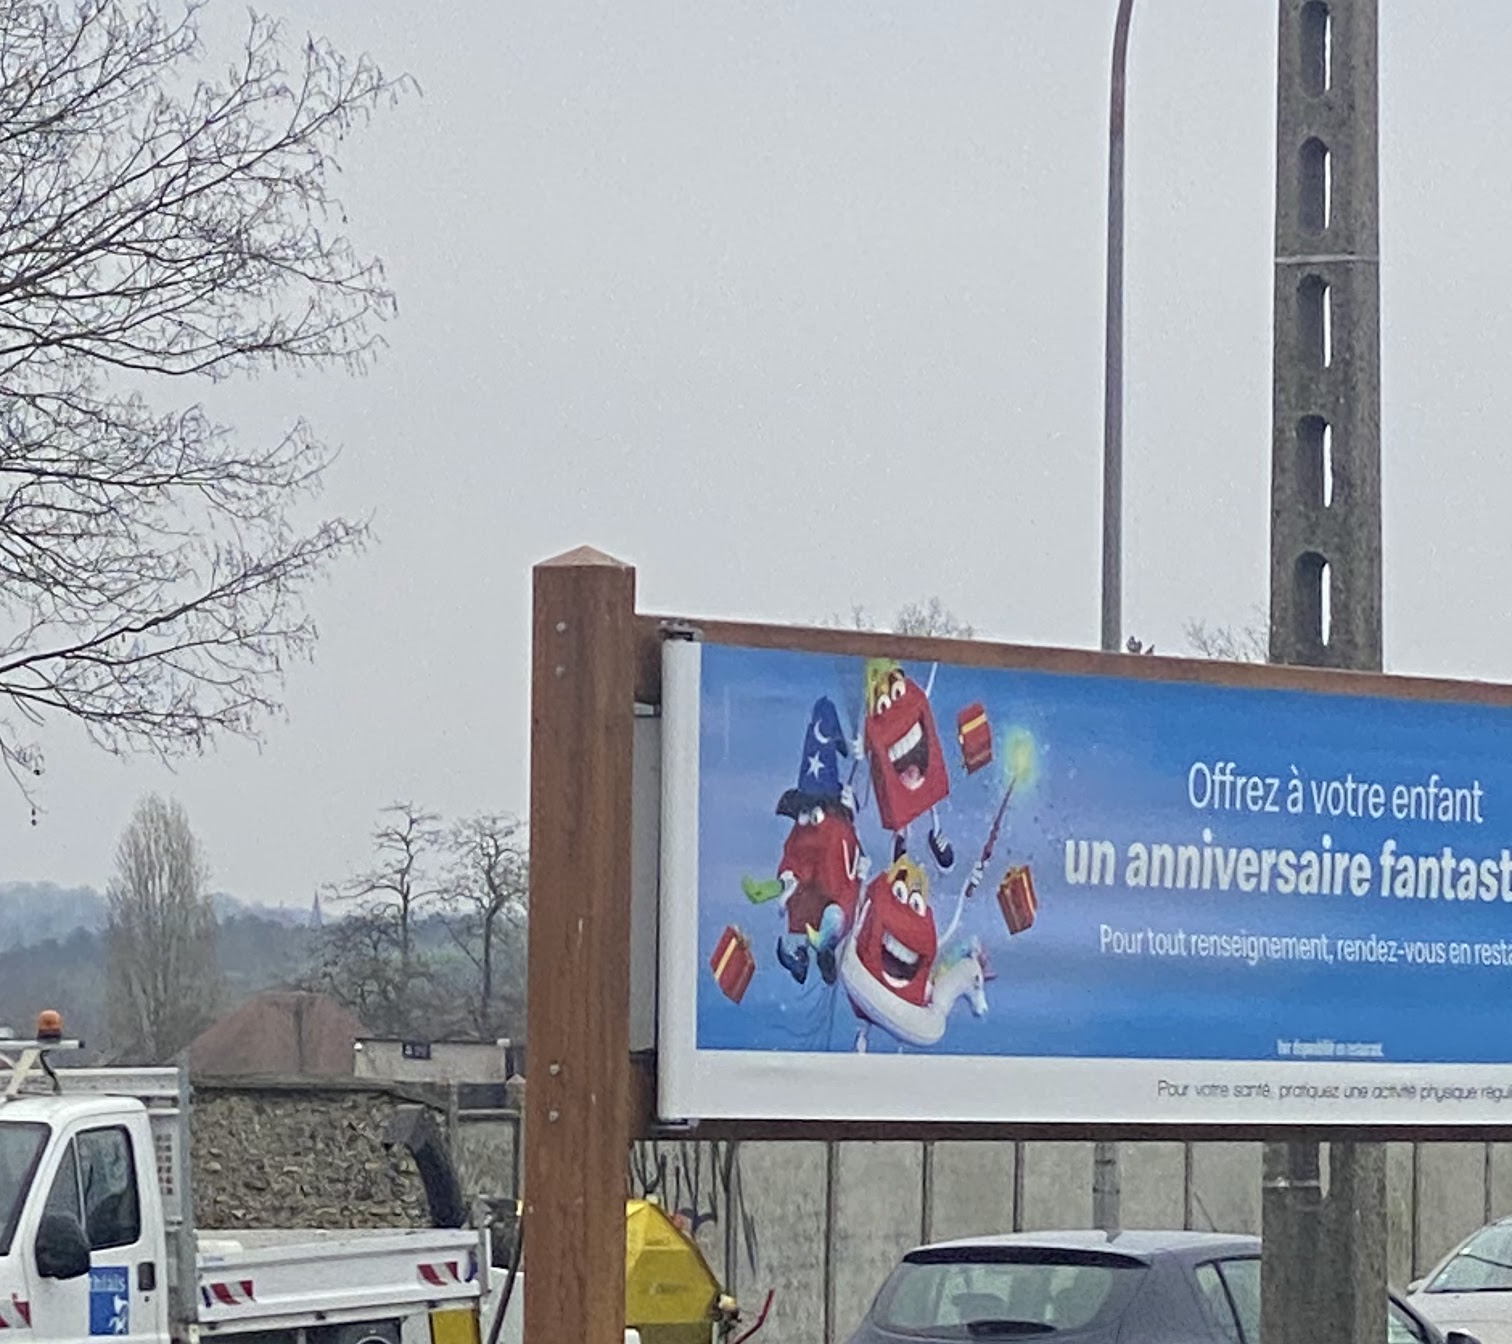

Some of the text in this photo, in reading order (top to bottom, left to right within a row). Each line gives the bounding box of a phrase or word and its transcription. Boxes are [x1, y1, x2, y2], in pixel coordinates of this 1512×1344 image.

[1188, 761, 1484, 824] Offrez à votre enfant
[1064, 838, 1116, 886] un
[1125, 827, 1372, 897] anniversaire
[1099, 923, 1145, 955] Pour
[1145, 926, 1188, 957] tout
[1189, 929, 1334, 966] renseignement,
[1336, 934, 1447, 964] rendez-vous
[1448, 942, 1472, 965] en
[1157, 1079, 1190, 1098] Pour
[1193, 1082, 1230, 1099] votre
[1278, 1083, 1340, 1101] pratiquez
[1343, 1085, 1369, 1100] une
[1419, 1083, 1480, 1104] physique
